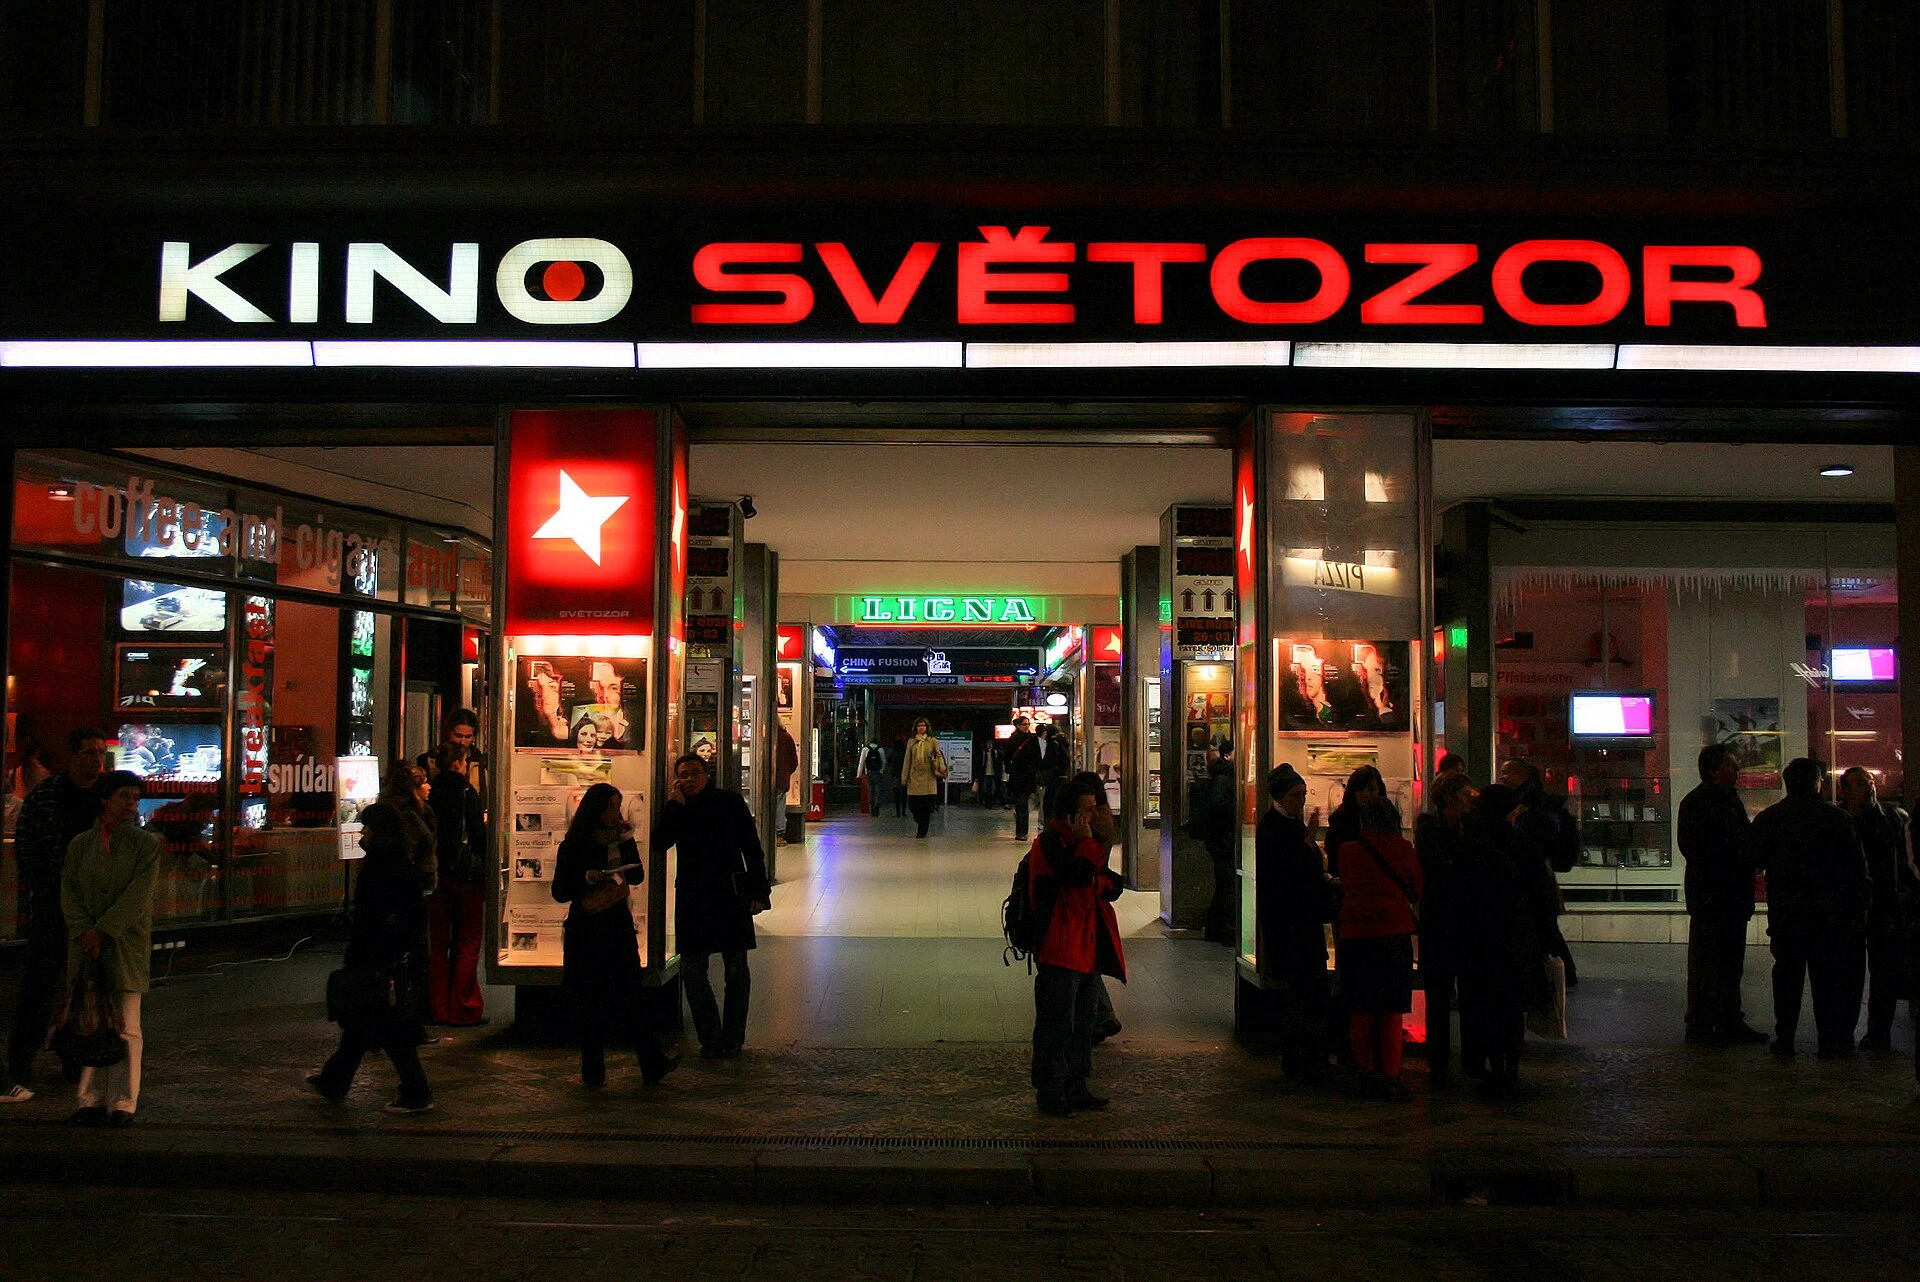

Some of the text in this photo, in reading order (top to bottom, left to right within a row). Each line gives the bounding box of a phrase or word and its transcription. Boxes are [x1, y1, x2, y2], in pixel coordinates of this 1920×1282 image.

[159, 225, 1769, 329] KINO SVĚTOZOR
[73, 475, 203, 550] coffee
[219, 504, 284, 565] and
[408, 542, 458, 592] and
[861, 597, 1037, 623] LIGNA
[240, 601, 267, 794] breakfast
[842, 658, 918, 667] CHINA FUSION
